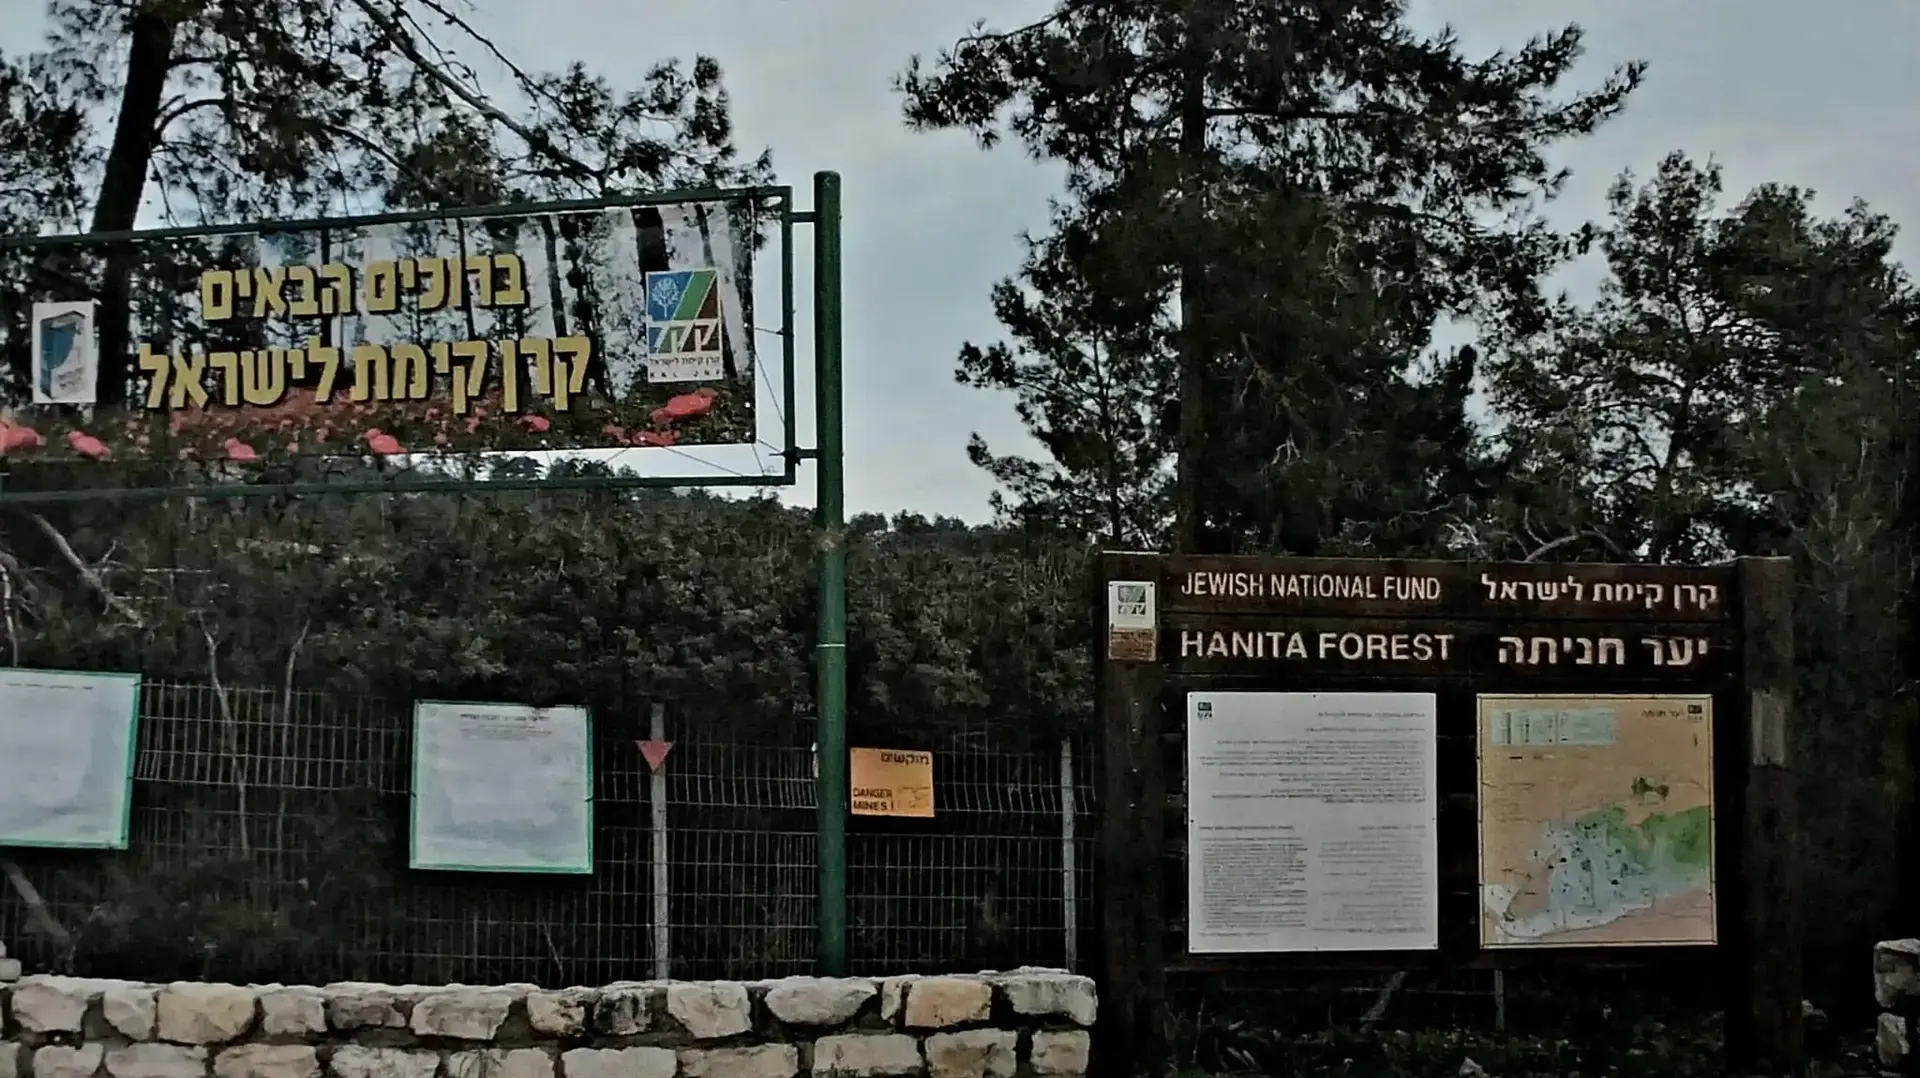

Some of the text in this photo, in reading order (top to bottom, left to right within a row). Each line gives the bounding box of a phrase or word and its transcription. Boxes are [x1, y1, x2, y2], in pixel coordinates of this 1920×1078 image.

[202, 254, 525, 321] ברוכים הבאים
[139, 334, 591, 415] קרן קימת לישראל
[1181, 572, 1441, 600] JEWISH NATIONAL FUND
[1481, 573, 1718, 611] קרן קימת לישראל
[1181, 631, 1454, 661] HANITA FOREST
[1499, 636, 1709, 666] יער חניתה
[881, 752, 930, 766] מוקשים
[853, 787, 893, 798] DANGER
